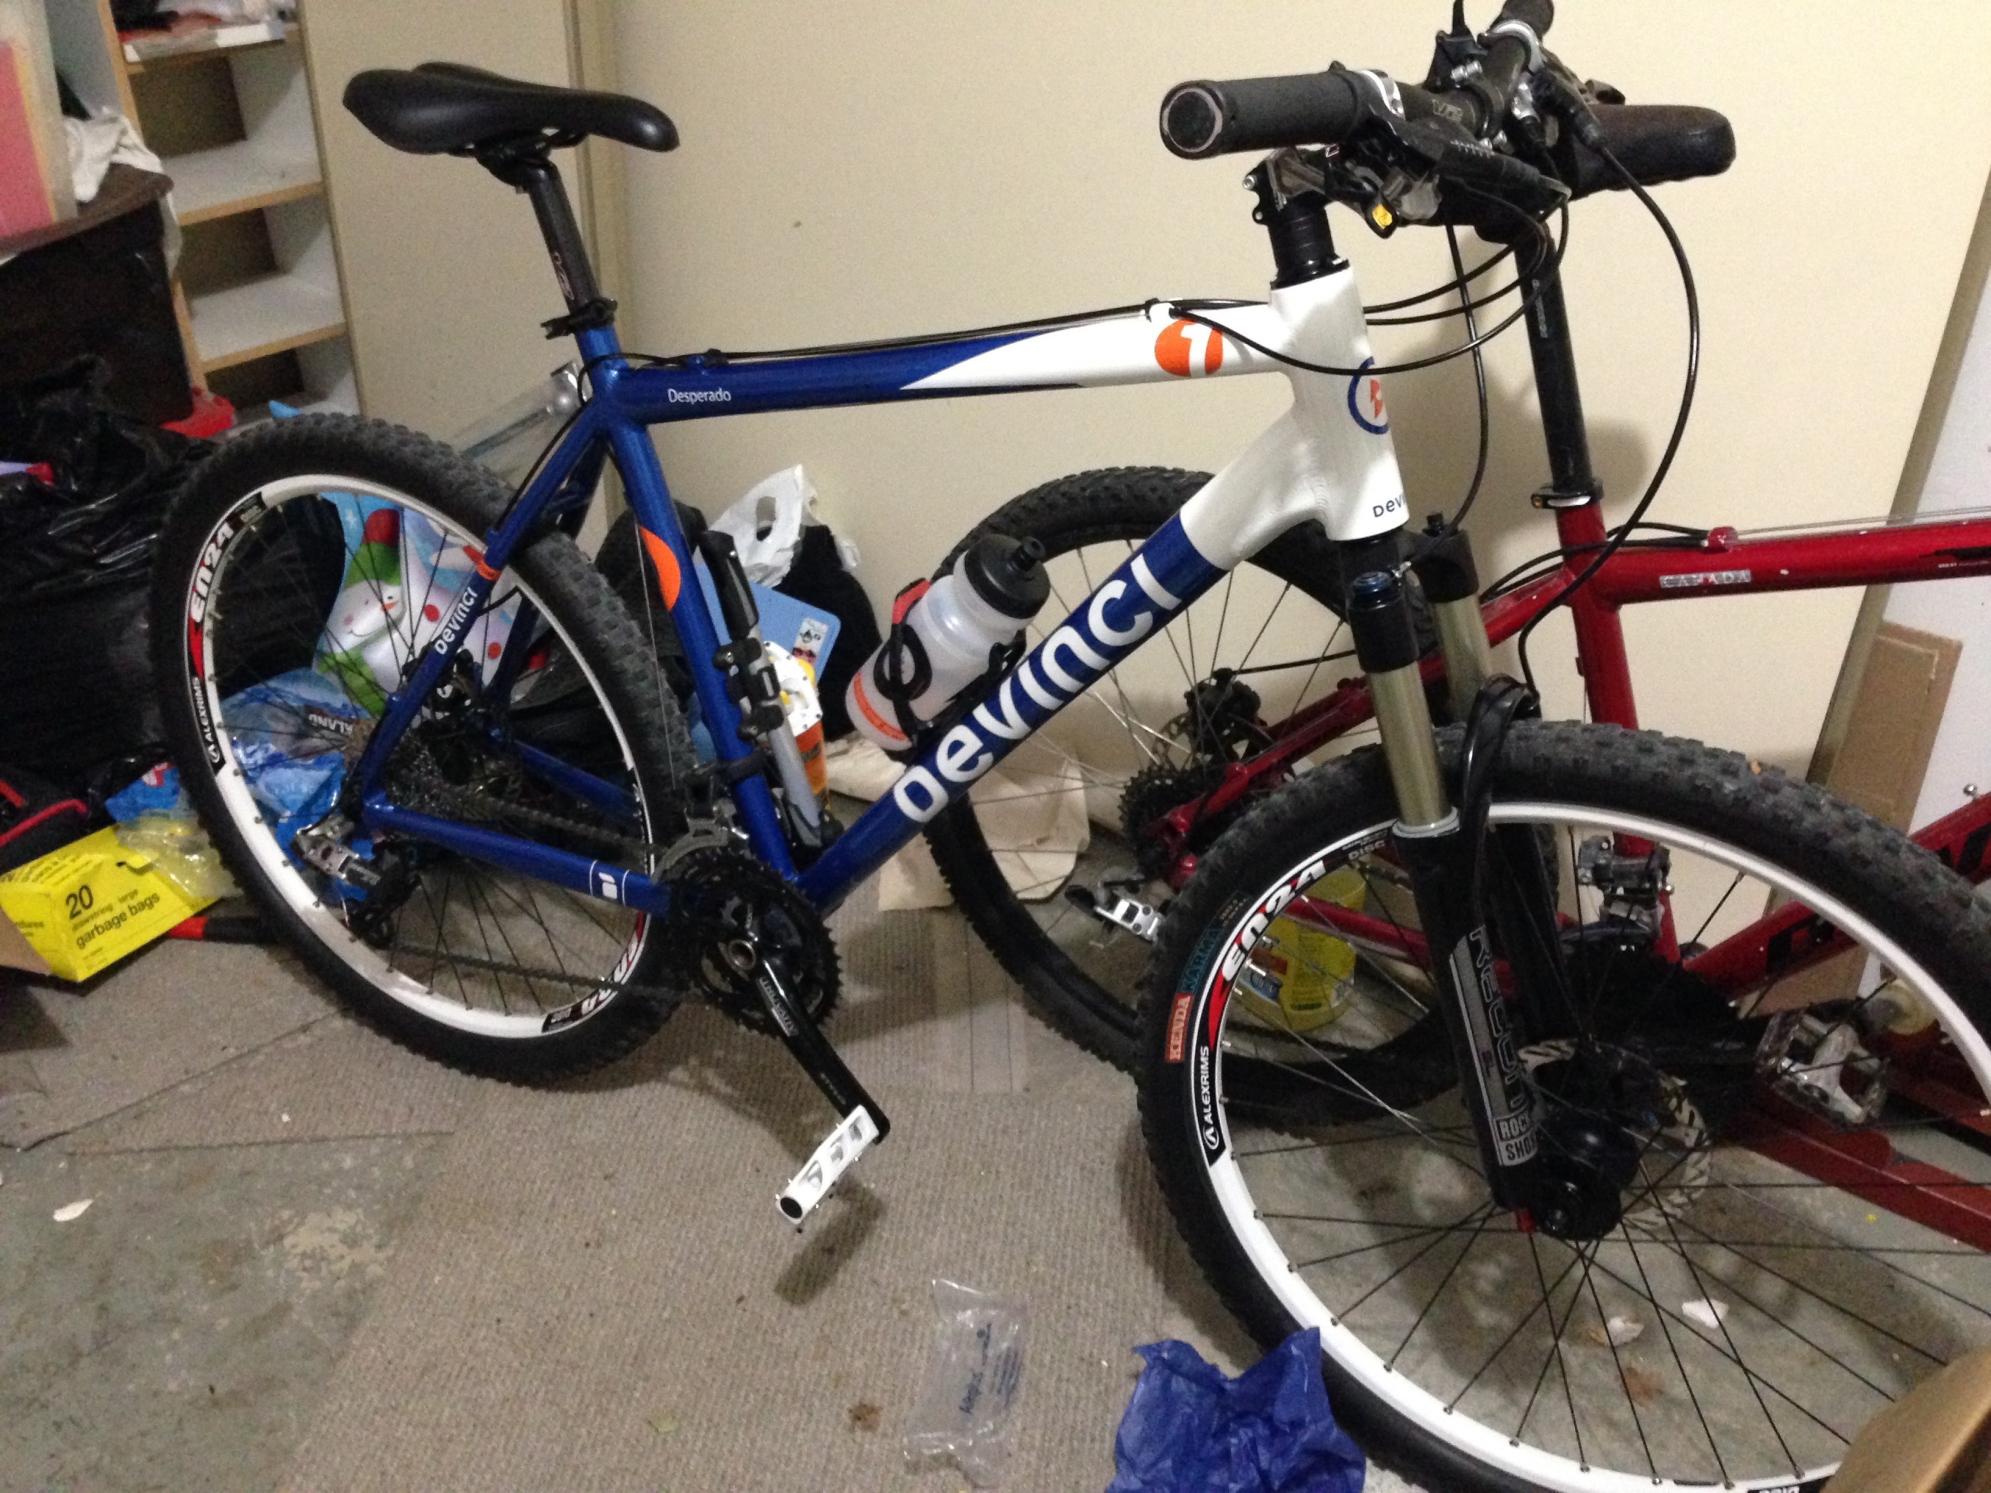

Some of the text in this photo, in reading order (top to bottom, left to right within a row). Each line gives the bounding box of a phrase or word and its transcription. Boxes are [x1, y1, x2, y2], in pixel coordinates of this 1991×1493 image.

[667, 387, 732, 405] Desperado
[65, 884, 94, 920] 20
[76, 911, 128, 949] garbage
[127, 892, 161, 917] bags
[1199, 1045, 1215, 1126] ALEXRIMS
